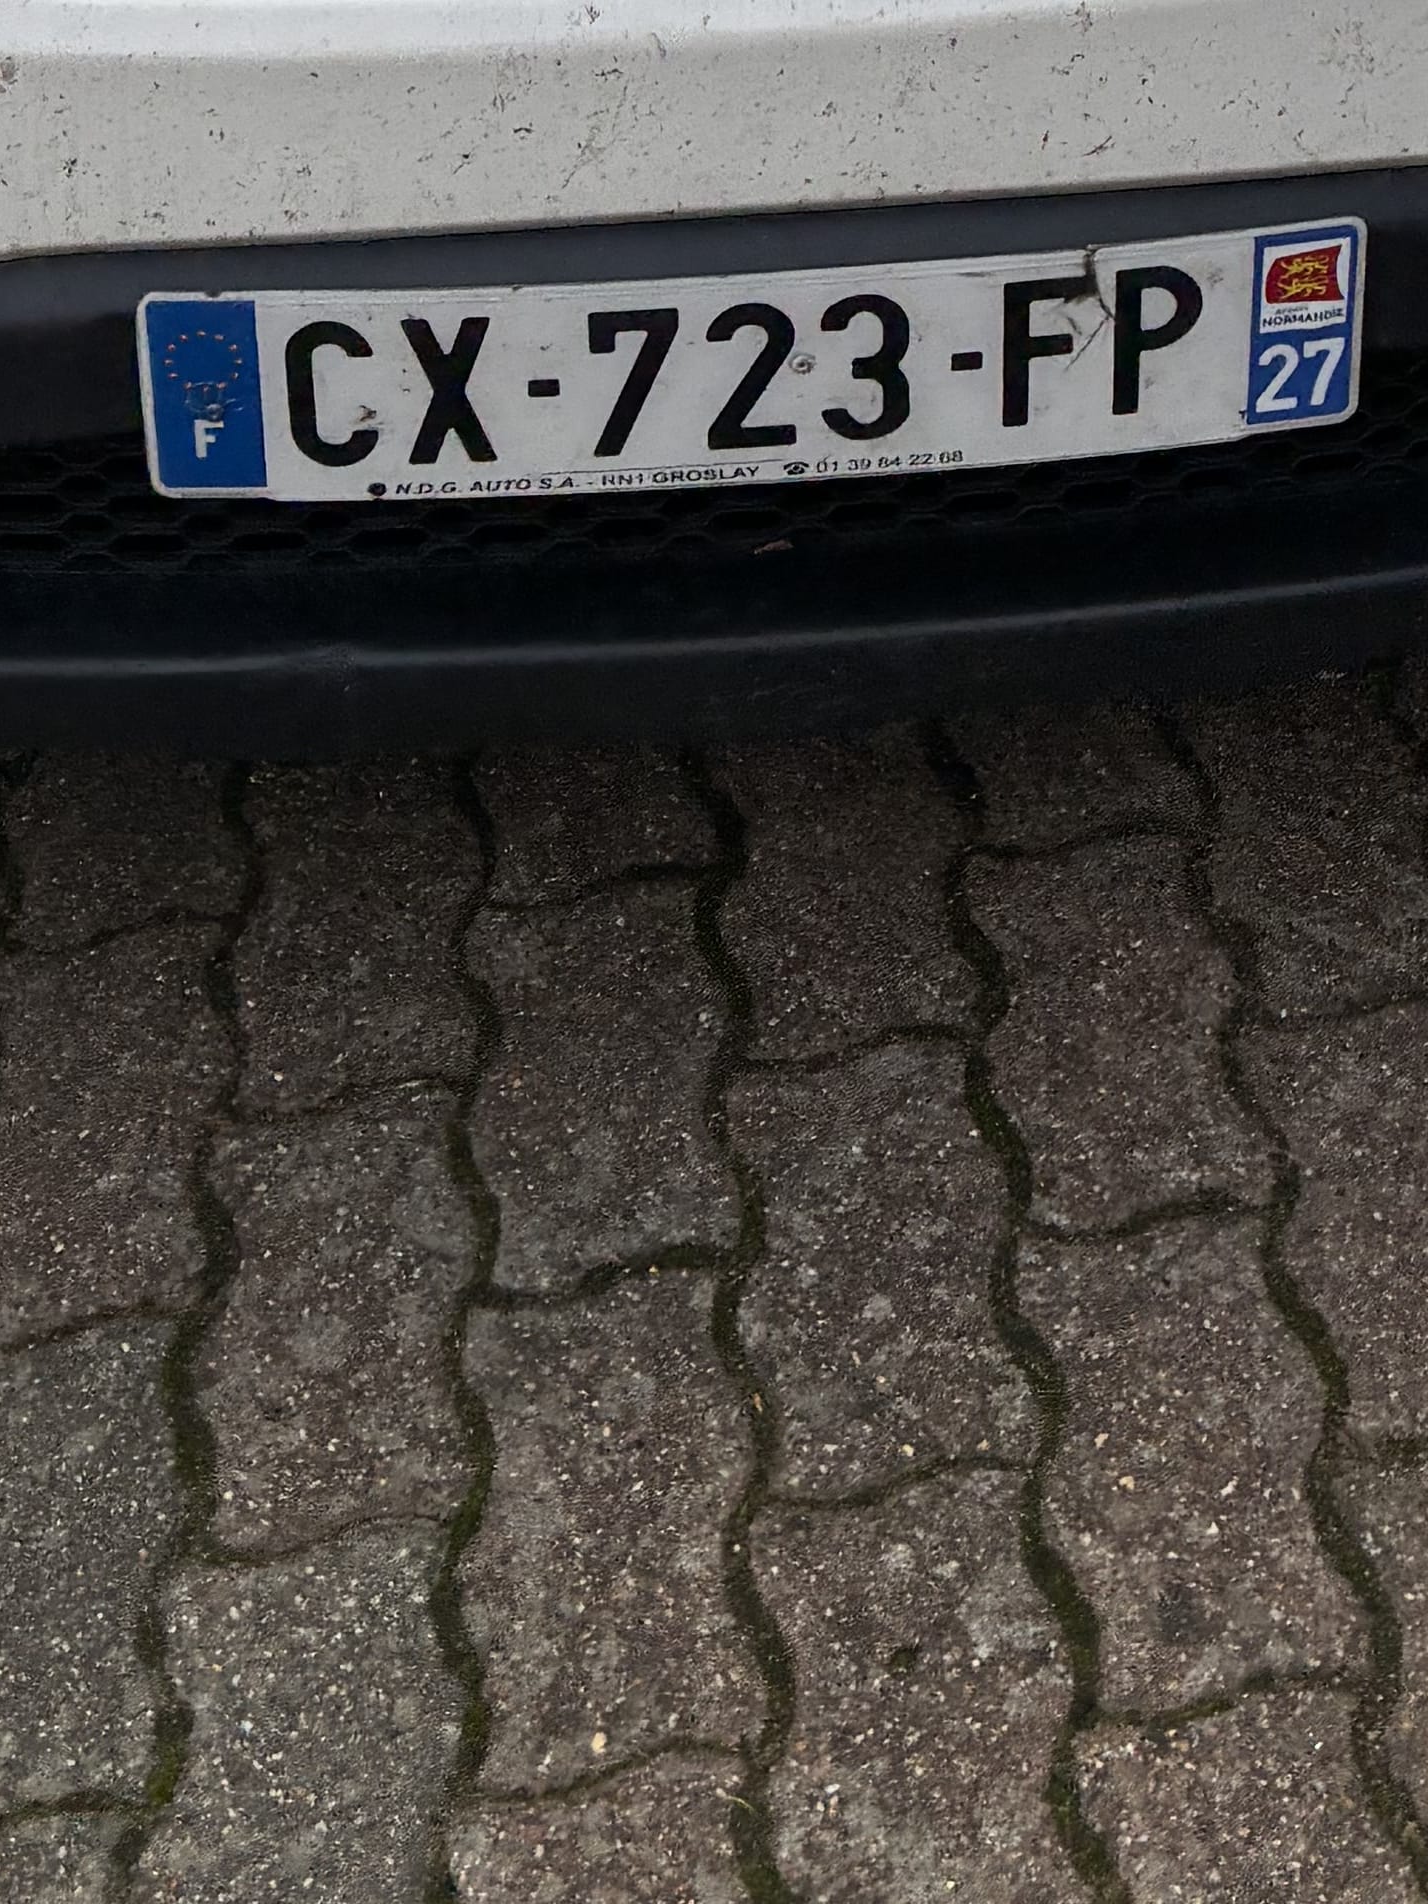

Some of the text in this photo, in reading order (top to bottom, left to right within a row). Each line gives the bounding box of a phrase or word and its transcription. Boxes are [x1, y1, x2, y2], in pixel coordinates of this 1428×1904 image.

[1262, 307, 1345, 328] NORMANDIE
[284, 265, 1204, 468] CX-723-FP
[1255, 336, 1346, 413] 27
[194, 419, 225, 459] F
[469, 478, 532, 492] AUTO
[652, 465, 760, 484] GROSLAY
[816, 460, 838, 474] 01
[908, 453, 933, 466] 22
